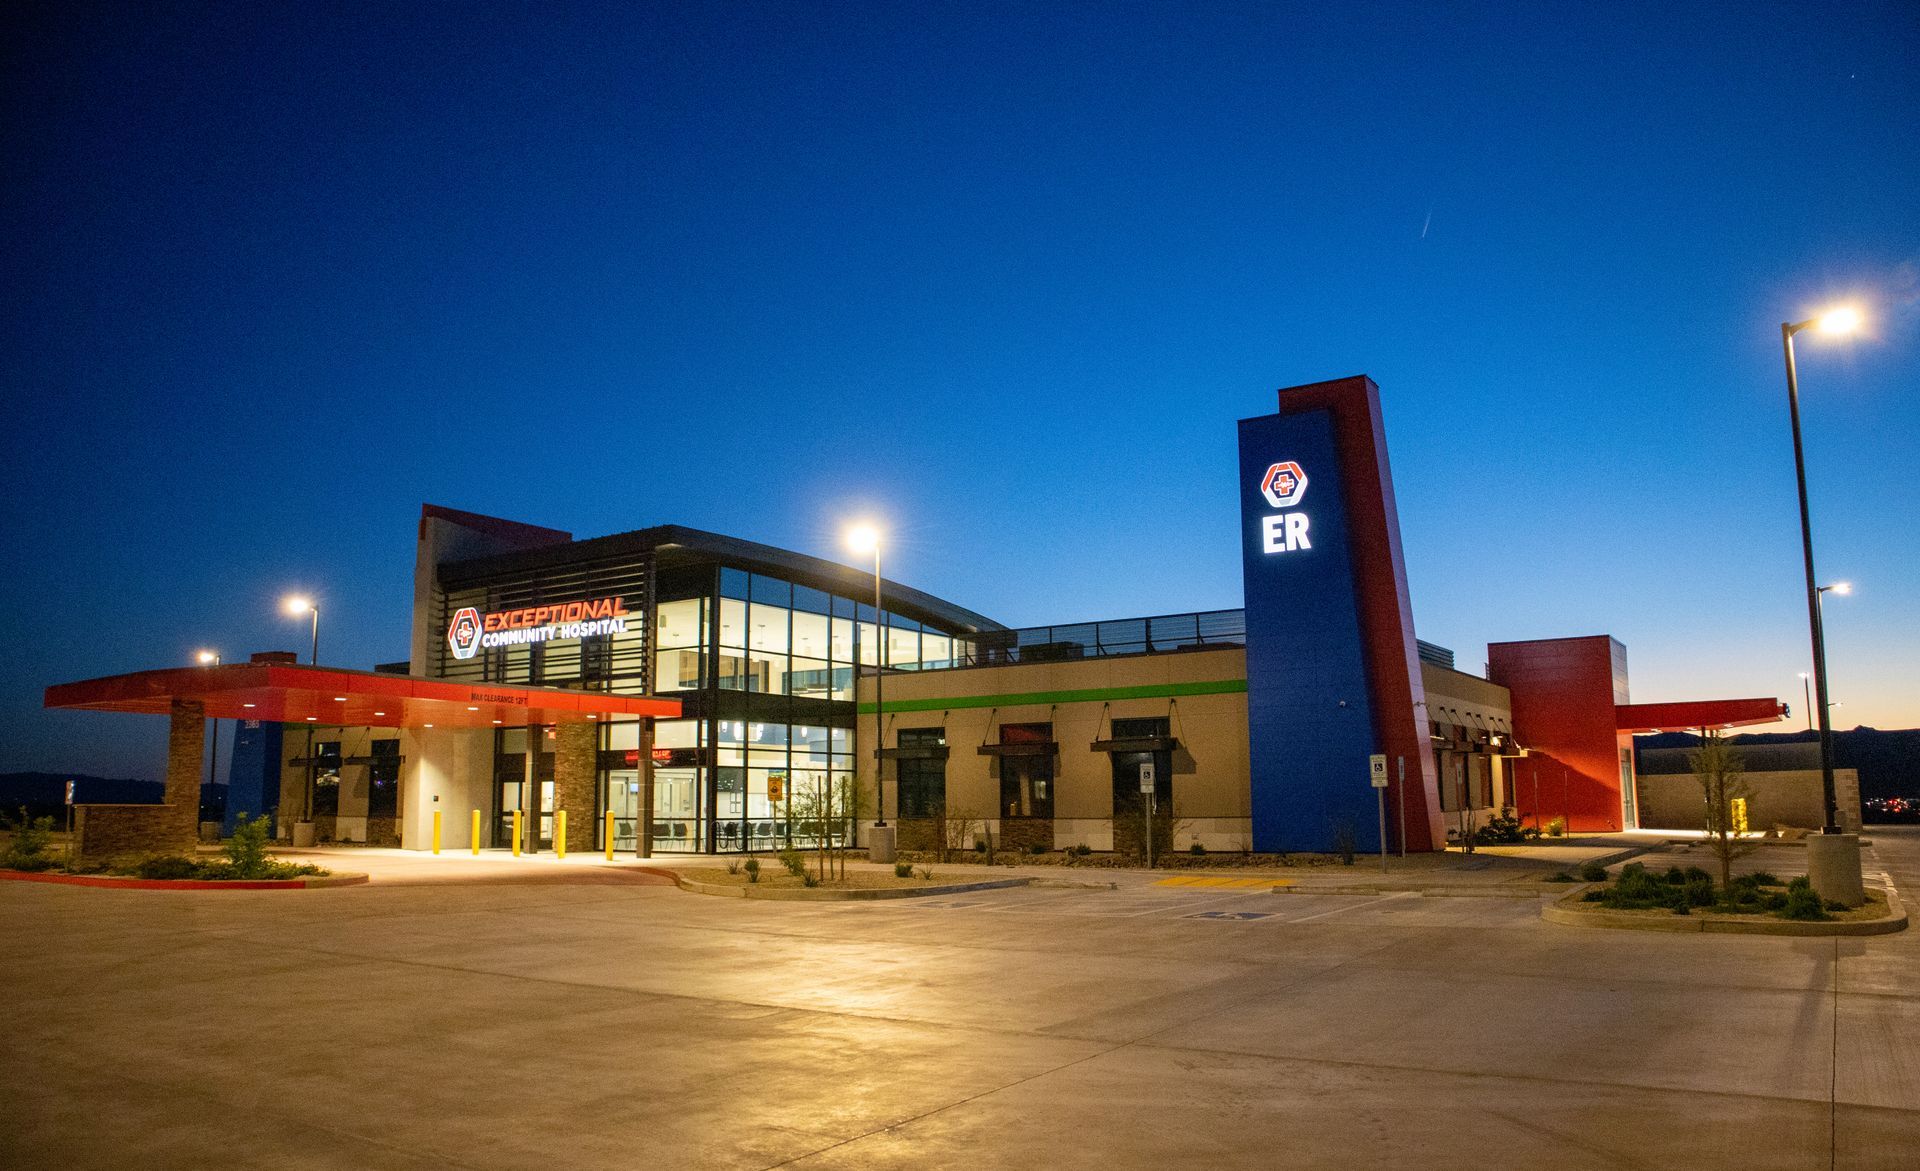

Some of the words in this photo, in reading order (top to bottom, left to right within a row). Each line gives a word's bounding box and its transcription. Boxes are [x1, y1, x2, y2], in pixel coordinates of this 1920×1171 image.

[1262, 512, 1312, 554] ER
[484, 597, 629, 632] EXCEPTIONAL
[482, 625, 556, 648] COMMUNITY
[562, 618, 628, 640] HOSPITAL
[484, 694, 514, 704] CLEARANCE
